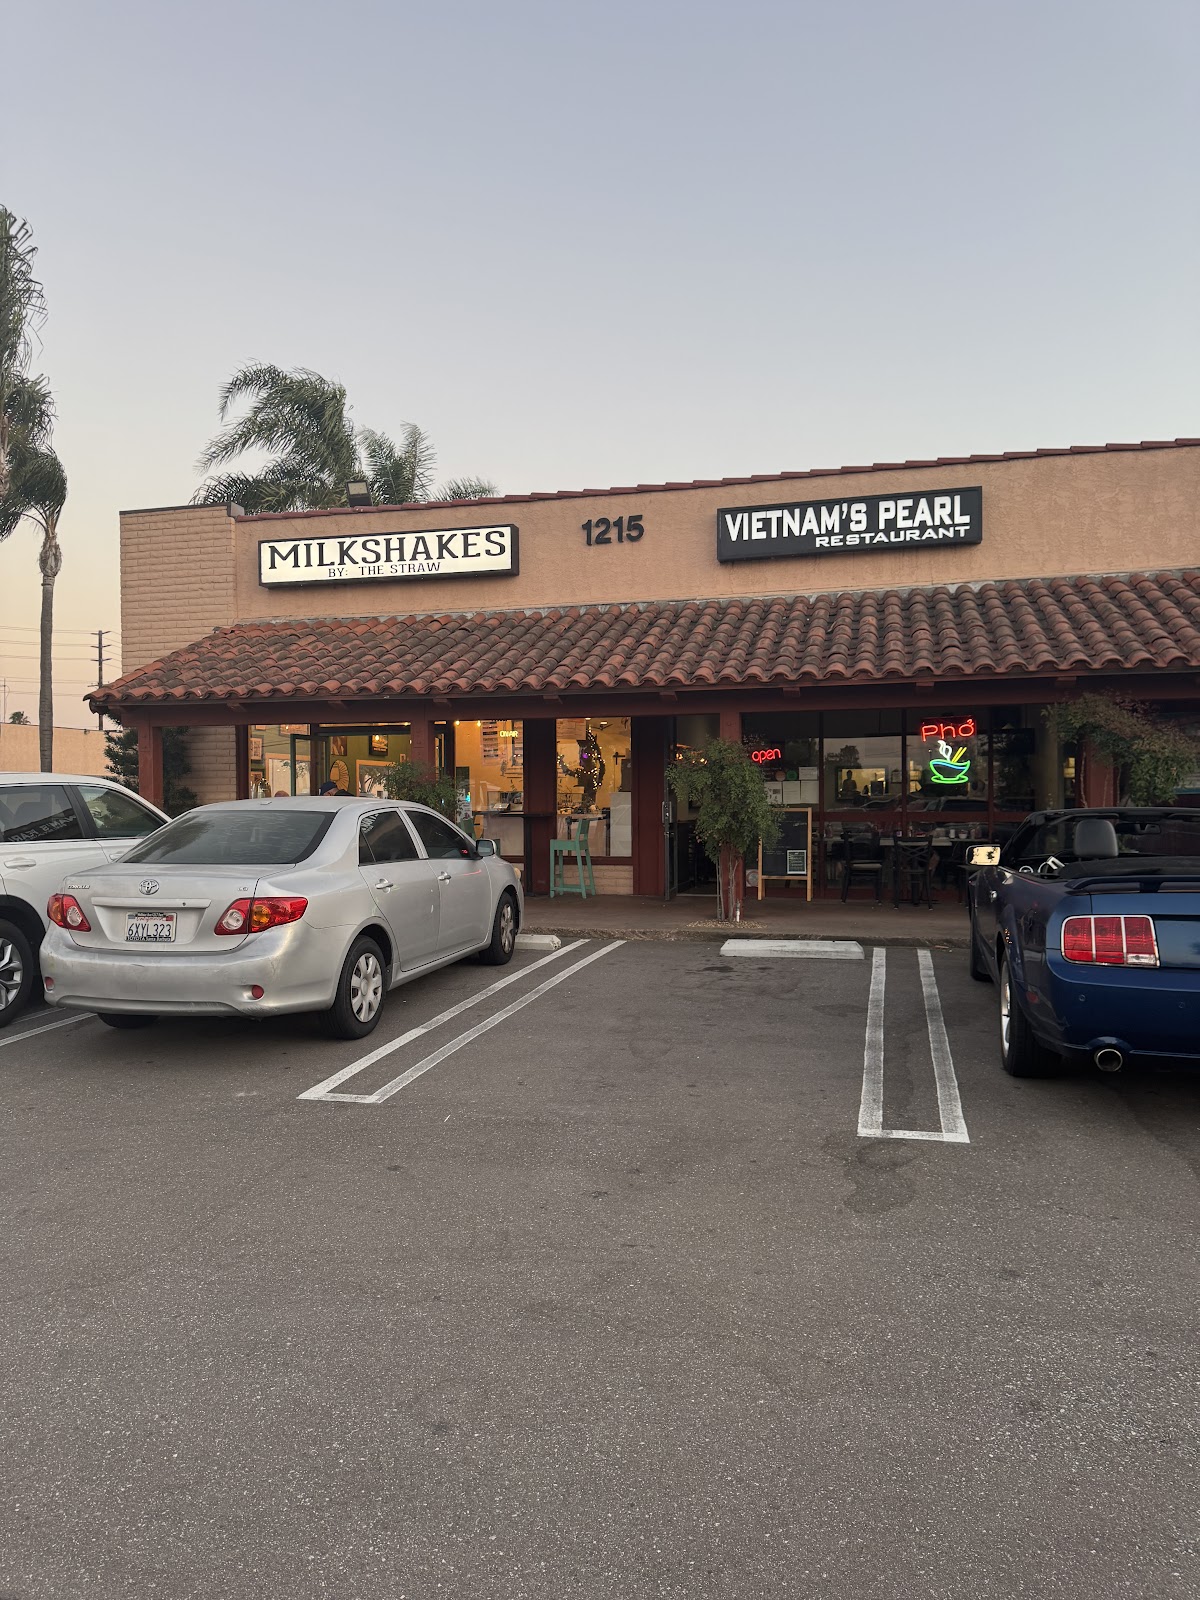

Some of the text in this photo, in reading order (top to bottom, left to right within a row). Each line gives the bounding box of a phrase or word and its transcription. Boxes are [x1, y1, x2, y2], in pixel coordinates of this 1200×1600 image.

[724, 495, 971, 542] VIETNAM'S PEARL
[581, 515, 646, 546] 1215
[815, 526, 971, 548] RESTAURANT
[268, 530, 506, 570] MILKSHAKES
[328, 561, 441, 578] BY: THE STRAW
[751, 748, 782, 764] open
[128, 923, 171, 937] 6XYL323
